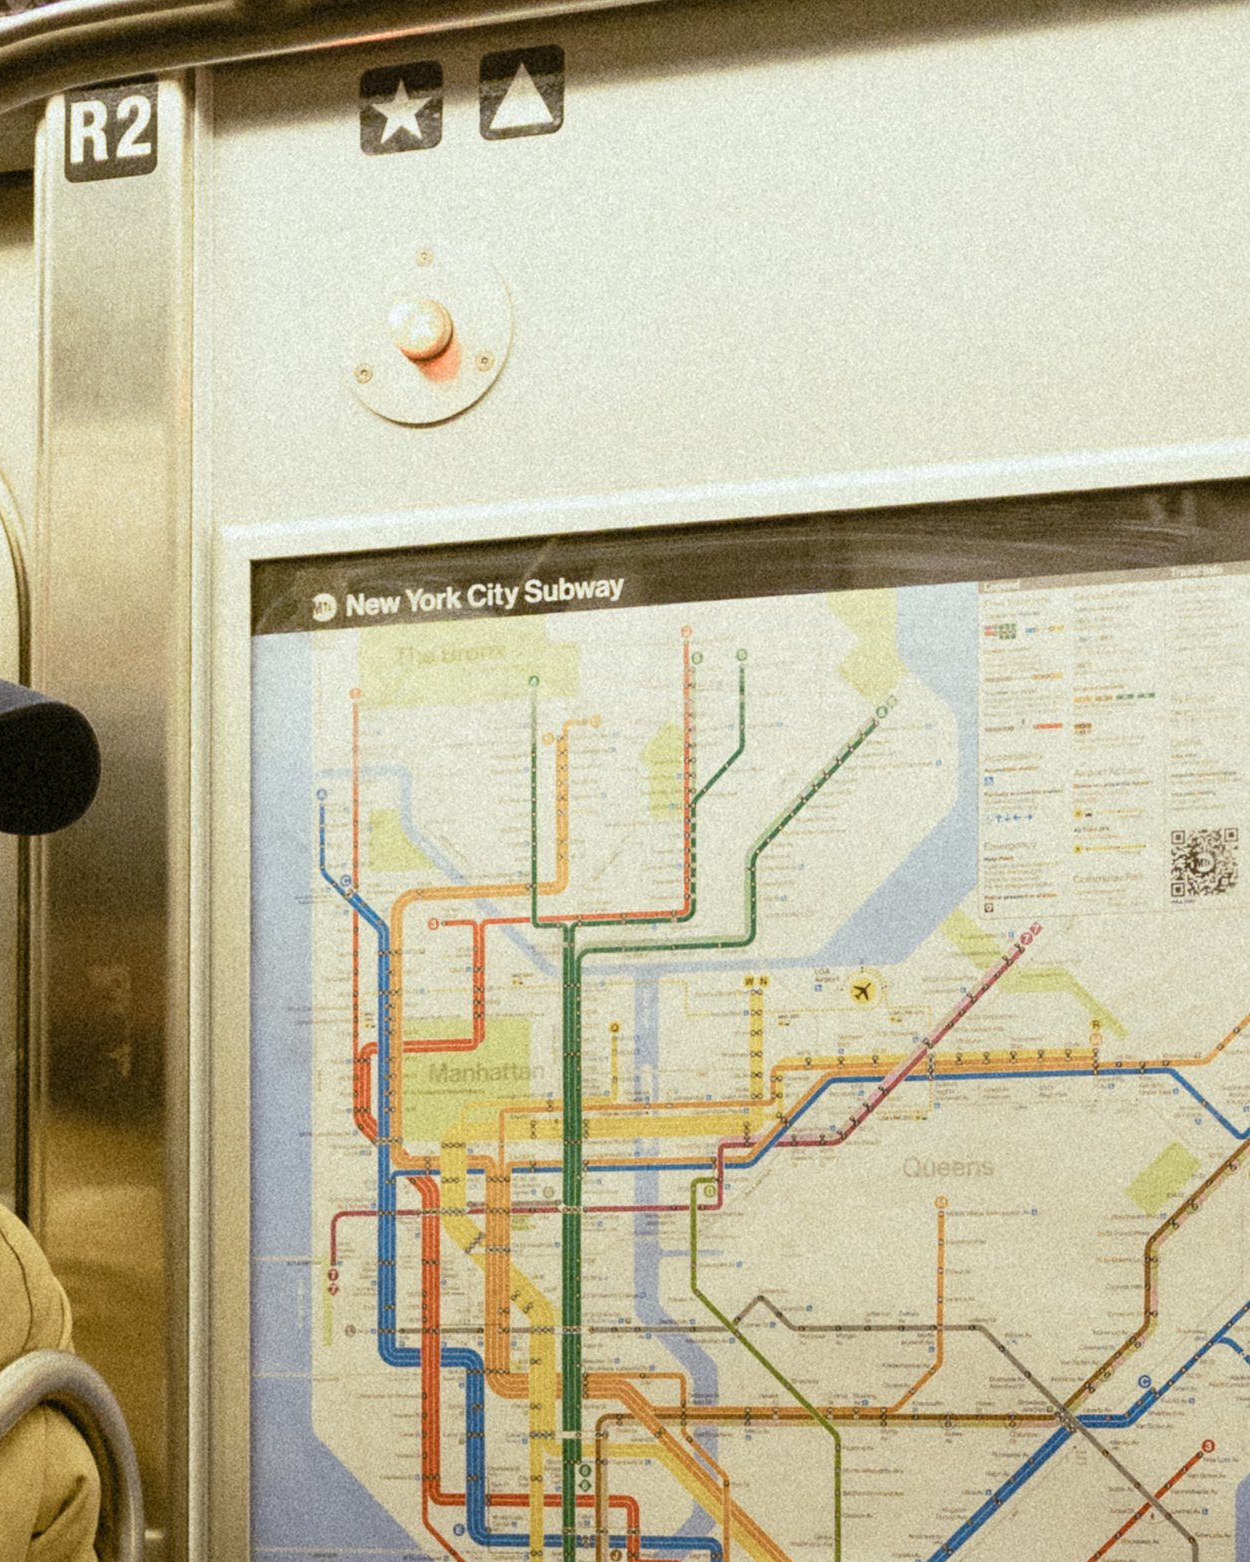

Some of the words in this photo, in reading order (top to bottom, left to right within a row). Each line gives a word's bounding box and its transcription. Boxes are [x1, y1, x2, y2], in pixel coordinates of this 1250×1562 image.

[69, 94, 152, 165] R2
[345, 592, 401, 618] New
[405, 586, 462, 613] York
[467, 583, 520, 610] City
[523, 576, 626, 604] Subway
[440, 643, 507, 665] Bronx
[430, 1062, 545, 1083] Manhattan
[903, 1155, 994, 1179] Queens
